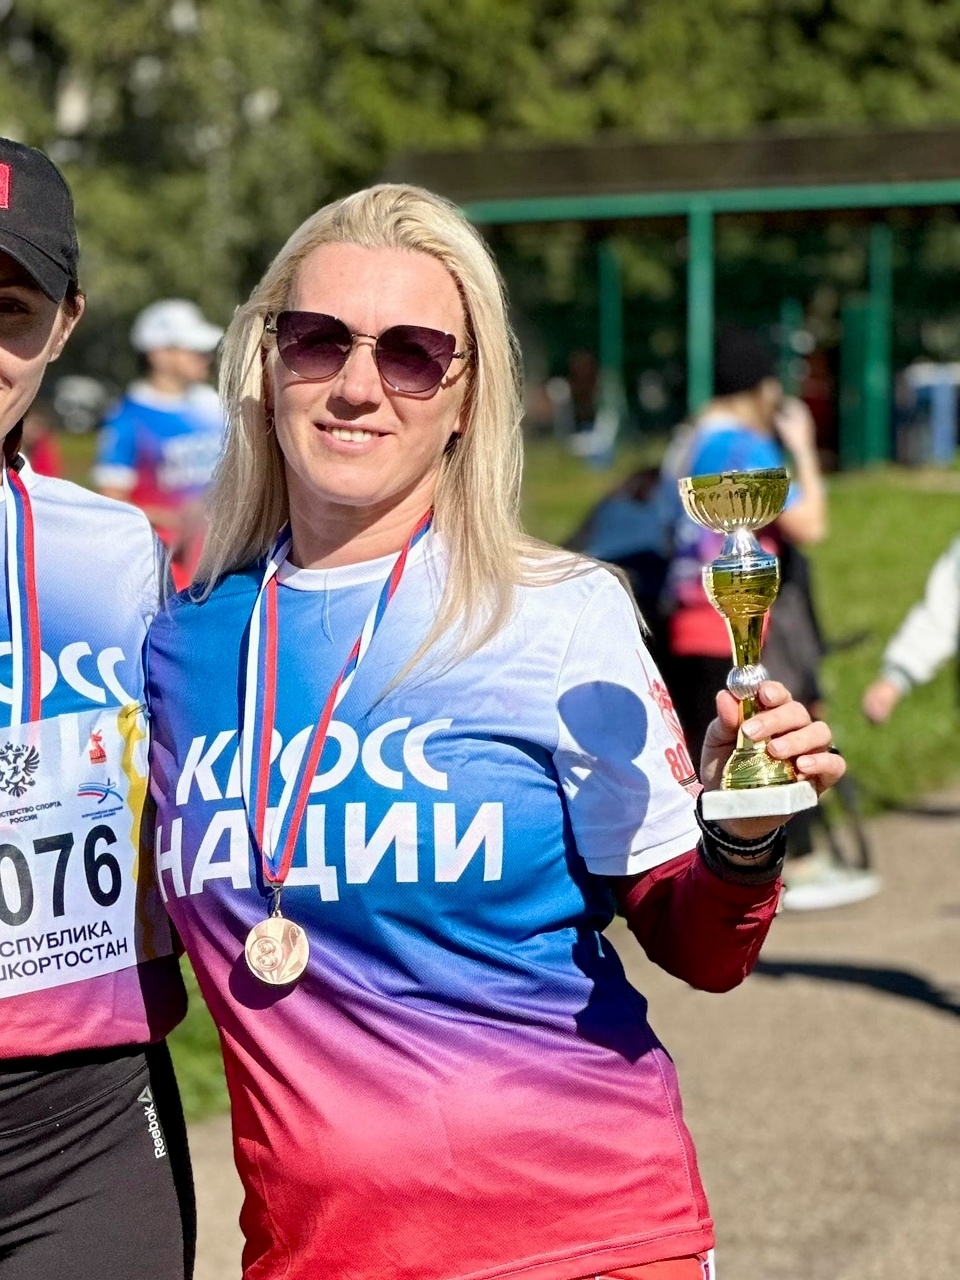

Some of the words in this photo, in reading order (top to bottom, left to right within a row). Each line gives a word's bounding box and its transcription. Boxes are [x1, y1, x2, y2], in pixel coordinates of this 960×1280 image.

[9, 813, 38, 825] РОССИИ
[35, 800, 63, 812] СПОРТА
[155, 801, 504, 903] НАЦИИ
[144, 1102, 167, 1159] Reebok
